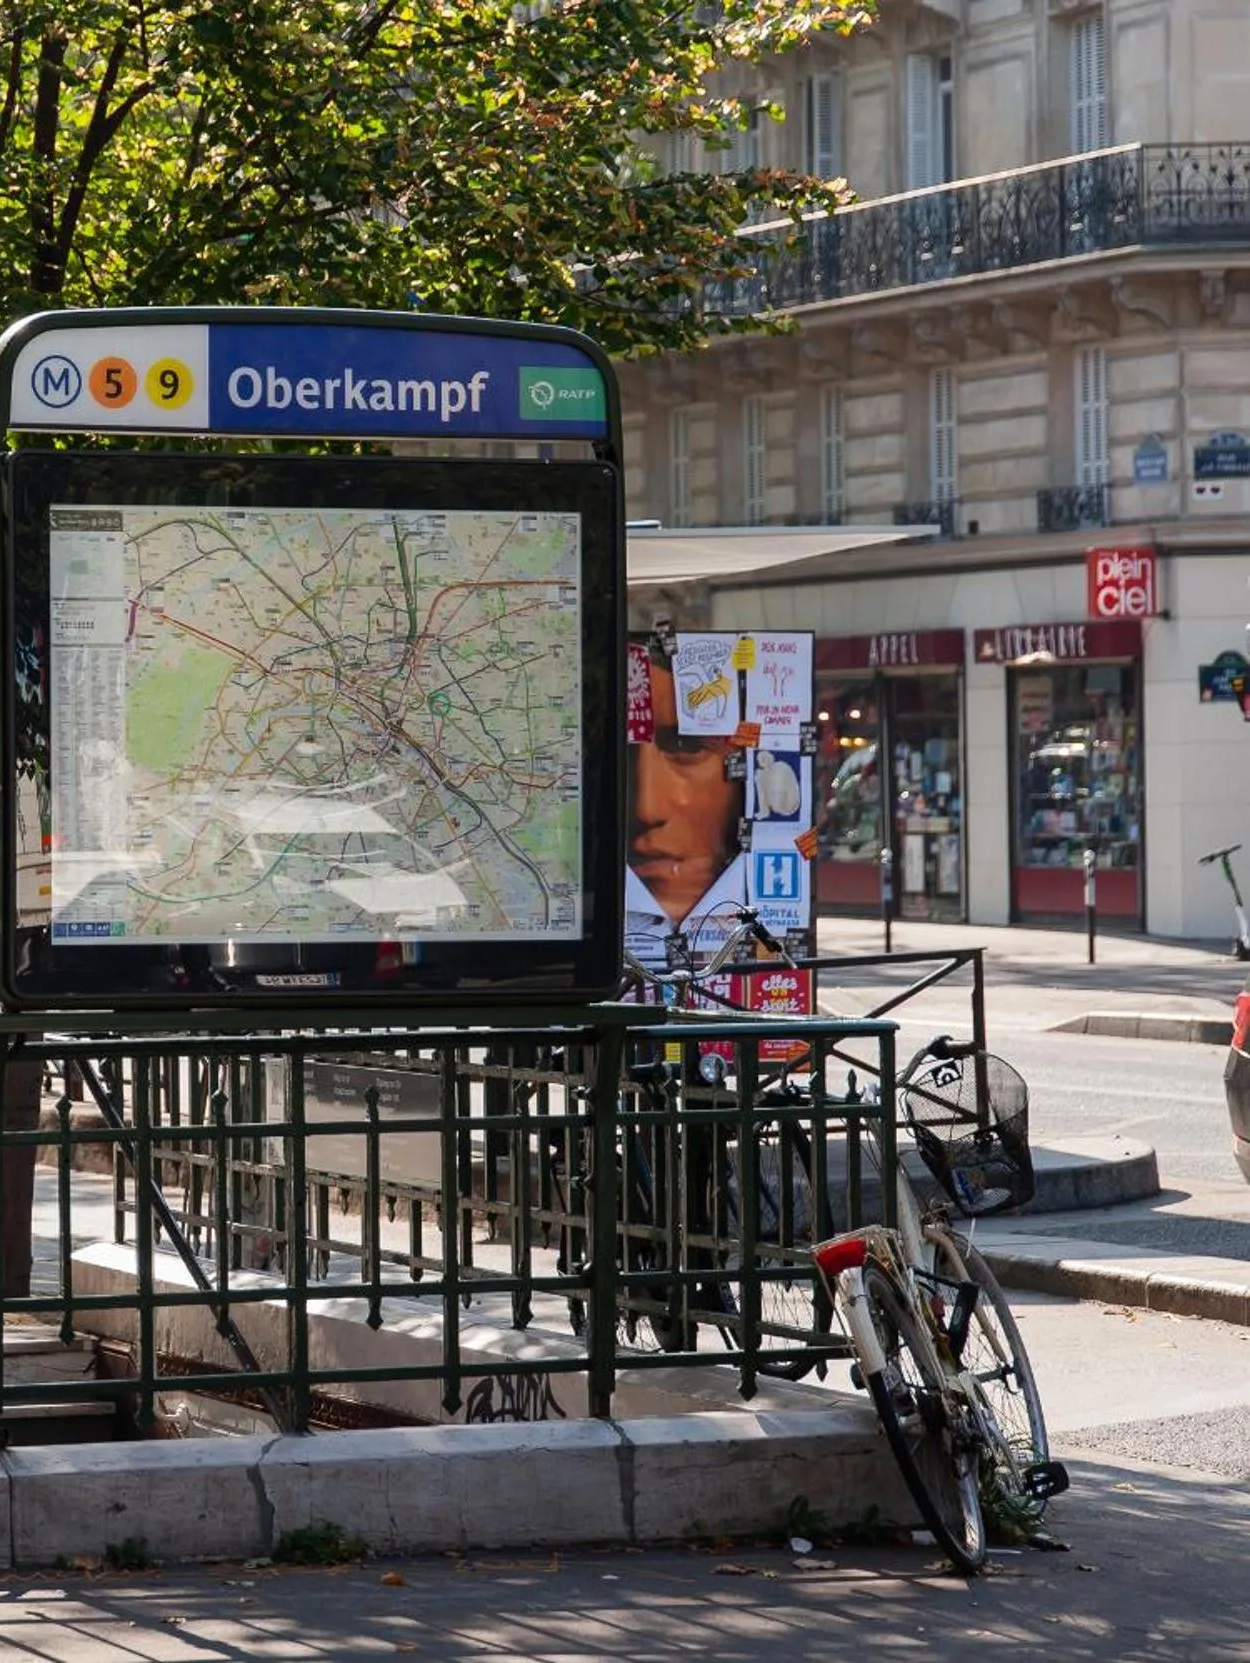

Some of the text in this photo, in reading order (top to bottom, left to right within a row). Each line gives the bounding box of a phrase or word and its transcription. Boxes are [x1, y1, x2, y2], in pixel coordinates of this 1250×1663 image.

[43, 366, 596, 422] M 5 9 Oberkampf RATP
[1096, 551, 1152, 585] plein
[1096, 580, 1153, 616] ciel
[868, 633, 919, 666] APPEL
[761, 974, 798, 991] elles
